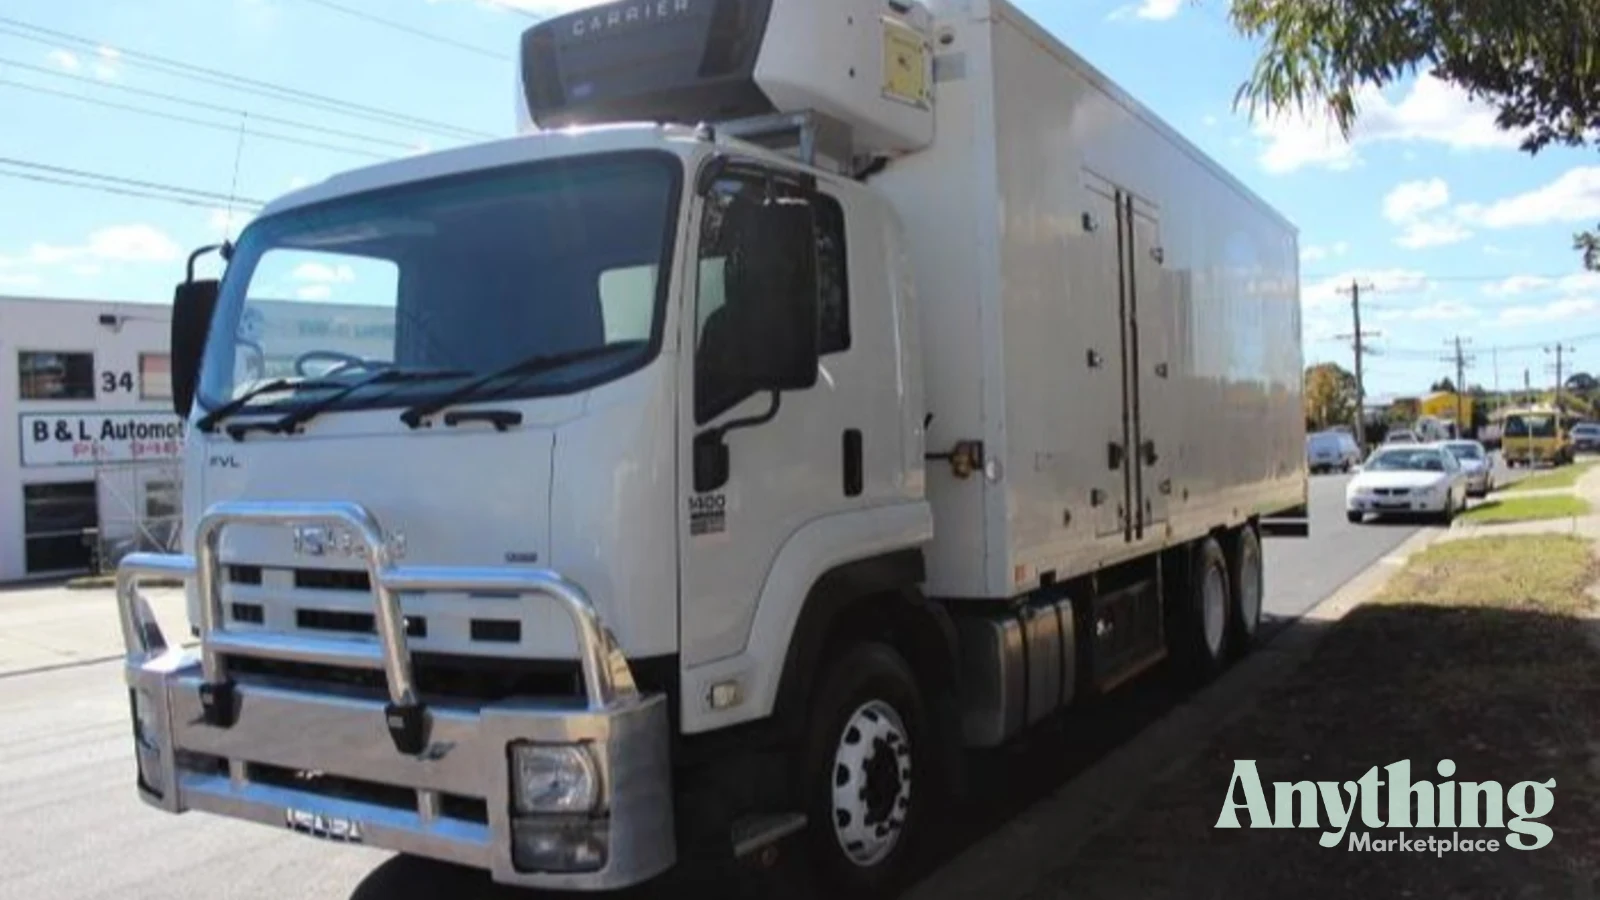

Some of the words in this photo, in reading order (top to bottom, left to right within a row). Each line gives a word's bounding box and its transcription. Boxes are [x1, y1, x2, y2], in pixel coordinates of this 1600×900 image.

[572, 0, 689, 36] CARRIER
[101, 370, 133, 393] 34
[34, 420, 49, 442] B
[54, 419, 73, 441] &
[79, 419, 92, 440] L
